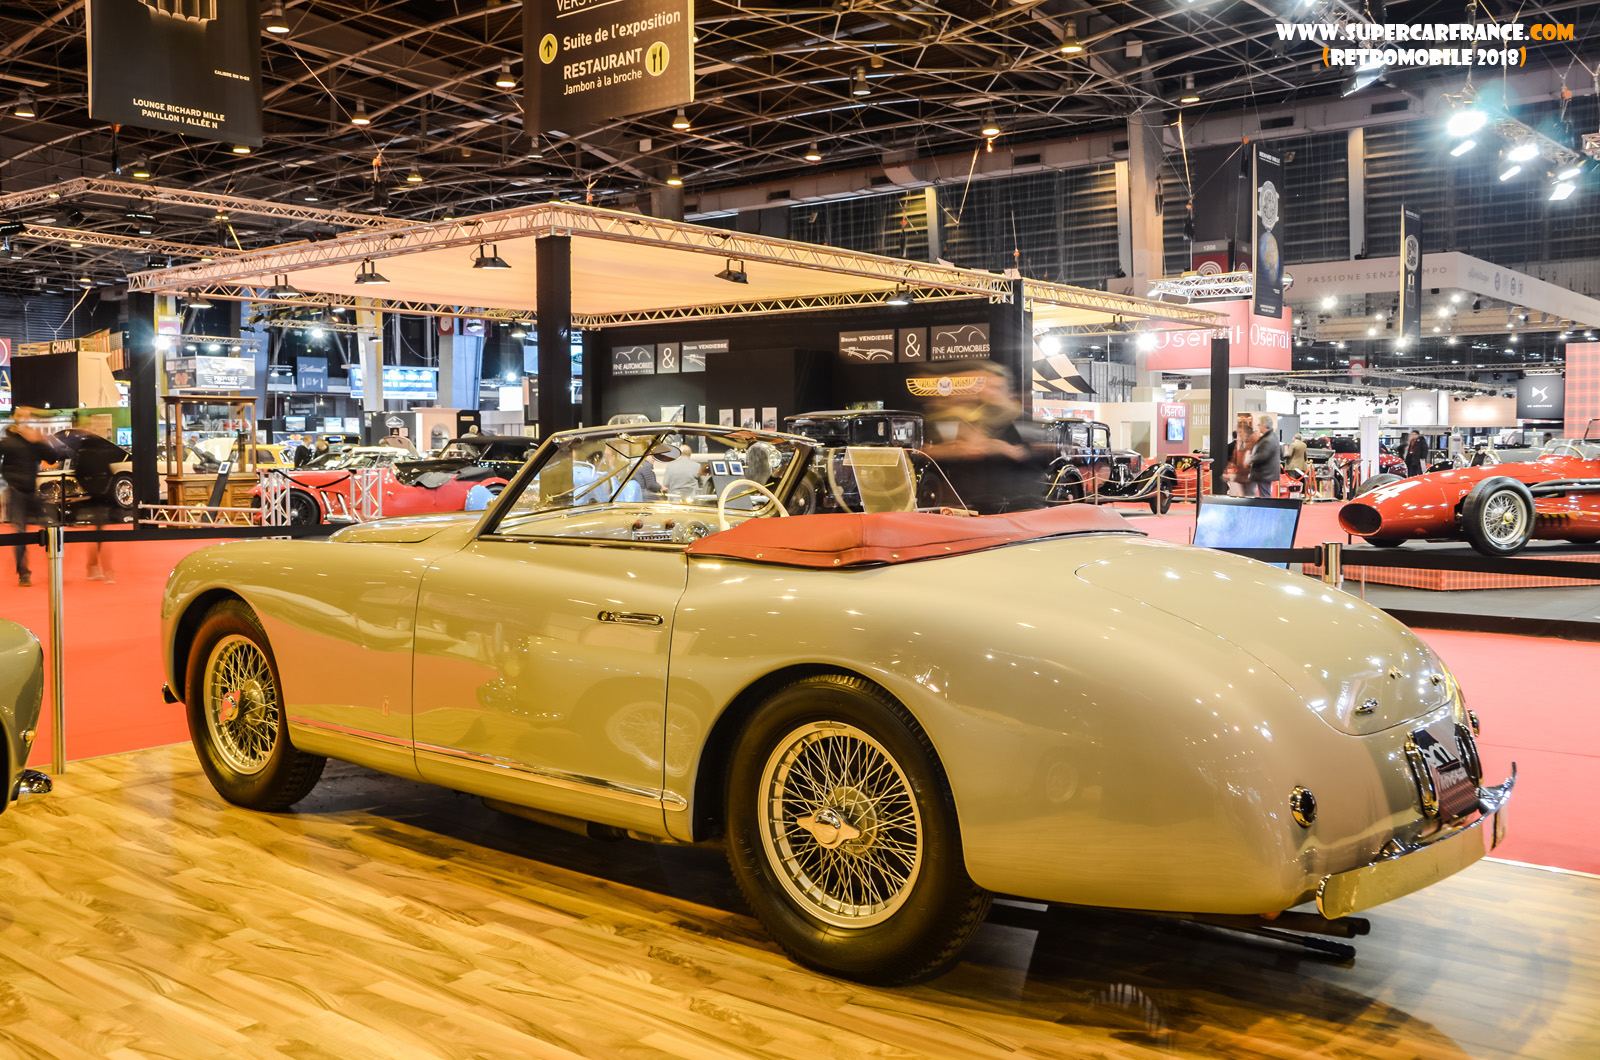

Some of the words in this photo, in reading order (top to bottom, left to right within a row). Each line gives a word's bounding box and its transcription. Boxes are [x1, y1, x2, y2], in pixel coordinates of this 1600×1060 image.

[563, 33, 592, 51] Suite
[594, 28, 609, 43] de
[563, 47, 643, 80] RESTAURANT
[563, 78, 596, 96] Jambon
[597, 76, 602, 88] à
[604, 75, 612, 86] la
[613, 68, 643, 84] broche
[132, 98, 166, 111] LOUNGE
[166, 104, 202, 117] RICHARD
[202, 111, 226, 122] MILLE
[141, 108, 180, 123] PAVILLON
[181, 116, 185, 124] 1
[186, 117, 211, 128] ALLÉE
[1307, 273, 1361, 284] PASSIONE
[1366, 270, 1401, 280] SENZA
[1421, 267, 1448, 275] MPO
[52, 340, 77, 354] CHAPAL
[859, 334, 893, 342] VENDIESSE
[905, 333, 921, 358] &
[1250, 323, 1290, 350] Osenat
[662, 347, 675, 369] &
[932, 346, 946, 355] FINE
[946, 343, 991, 354] AUTOMOBILES
[622, 361, 654, 370] AUTOMOBILES
